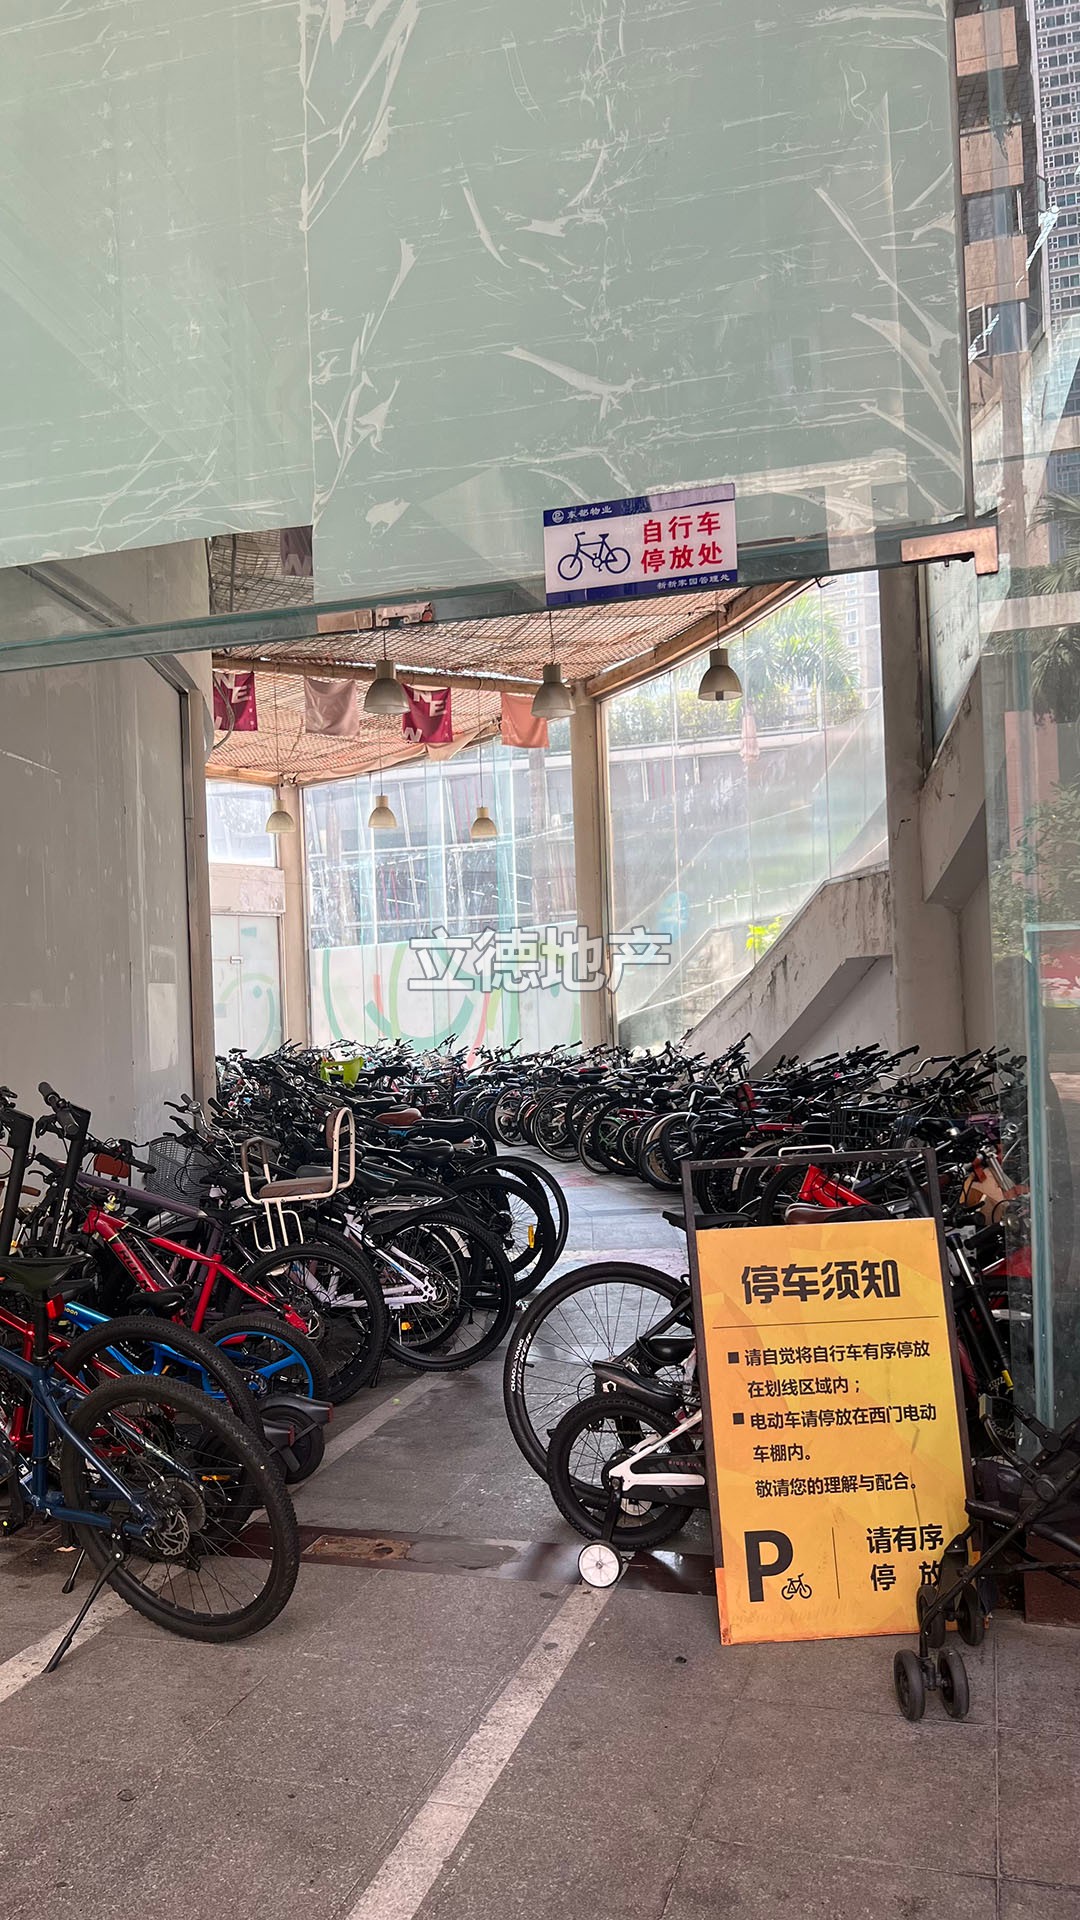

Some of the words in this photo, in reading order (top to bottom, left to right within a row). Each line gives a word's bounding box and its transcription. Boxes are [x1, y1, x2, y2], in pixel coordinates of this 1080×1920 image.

[643, 511, 721, 545] 自行车
[640, 541, 723, 575] 停放处
[741, 1259, 901, 1305] 停车须知
[744, 1340, 930, 1367] 请自觉将自行车有序停放
[750, 1404, 937, 1430] 电动车请停放在西门电动
[753, 1443, 811, 1463] 车棚内。
[755, 1471, 917, 1498] 敬请您的理解与配合。
[866, 1523, 945, 1554] 请有序
[743, 1529, 794, 1603] P
